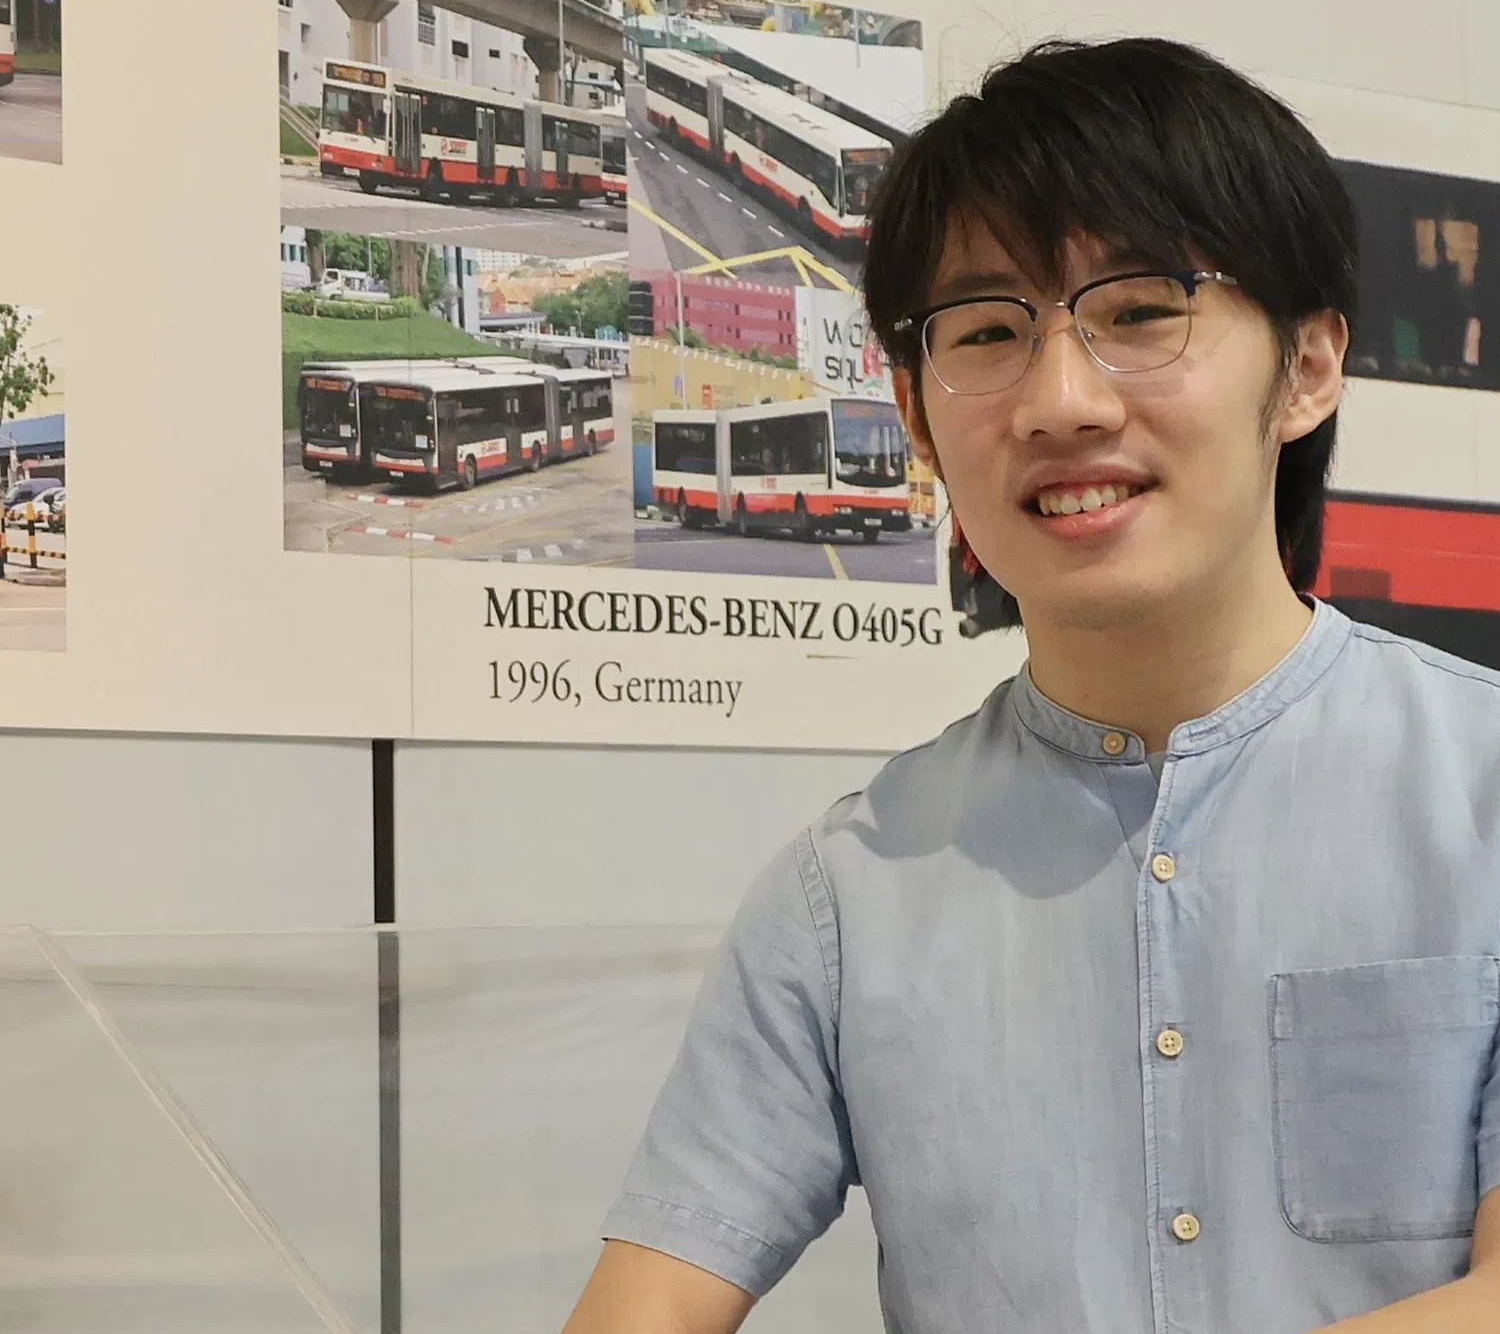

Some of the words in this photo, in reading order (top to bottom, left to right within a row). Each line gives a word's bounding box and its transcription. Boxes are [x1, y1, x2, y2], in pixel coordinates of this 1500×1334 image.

[483, 585, 825, 642] MERCEDES-BENZ
[487, 658, 584, 709] 1996,
[593, 660, 744, 717] Germany
